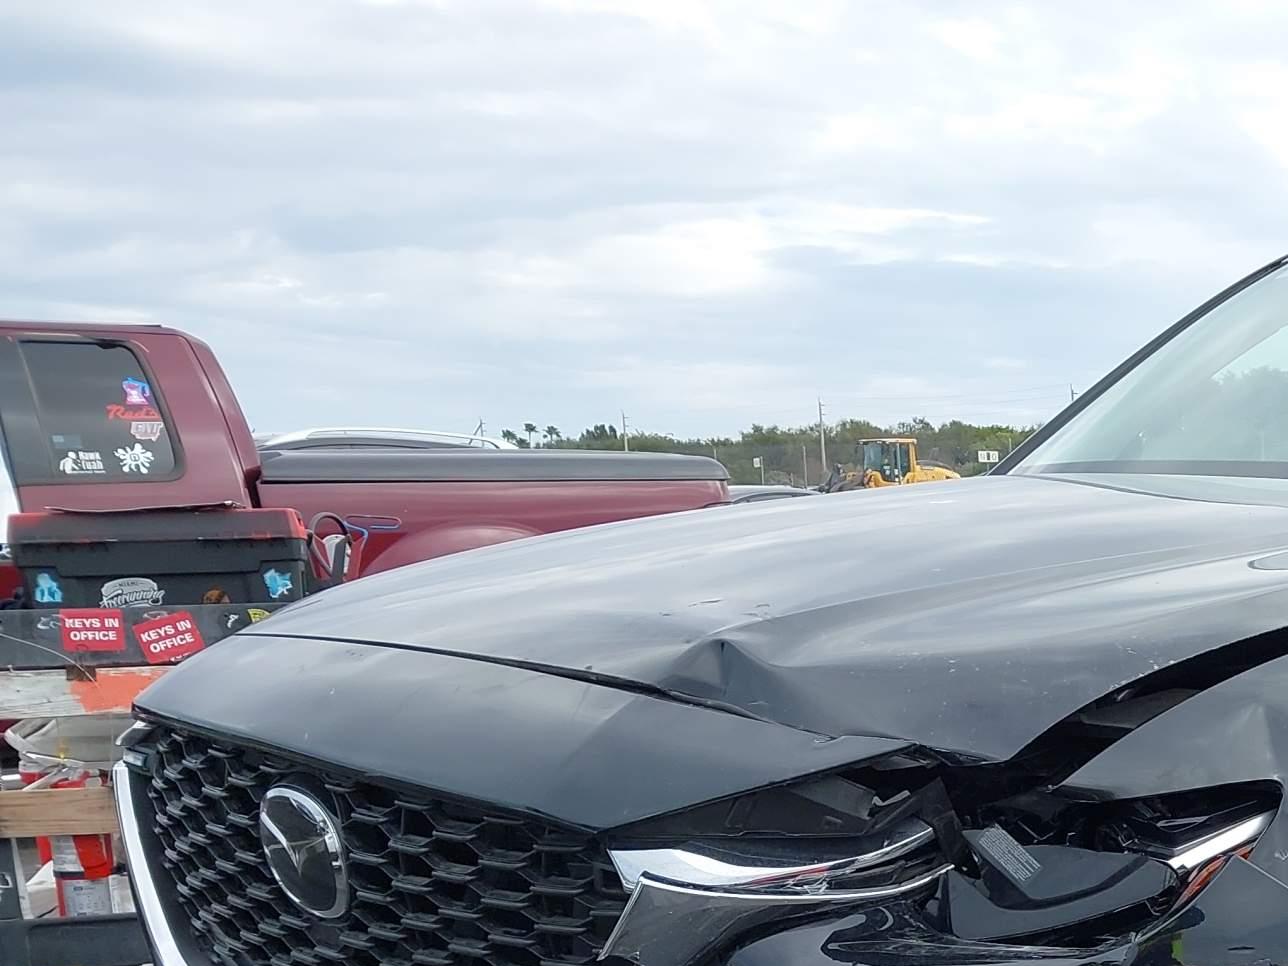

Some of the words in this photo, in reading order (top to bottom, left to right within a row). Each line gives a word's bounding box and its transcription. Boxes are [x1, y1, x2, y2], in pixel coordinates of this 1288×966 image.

[65, 618, 101, 628] KEYS
[104, 618, 119, 628] IN
[139, 624, 175, 643] KEYS
[176, 619, 192, 632] IN
[69, 630, 117, 641] OFFICE
[149, 632, 195, 653] OFFICE
